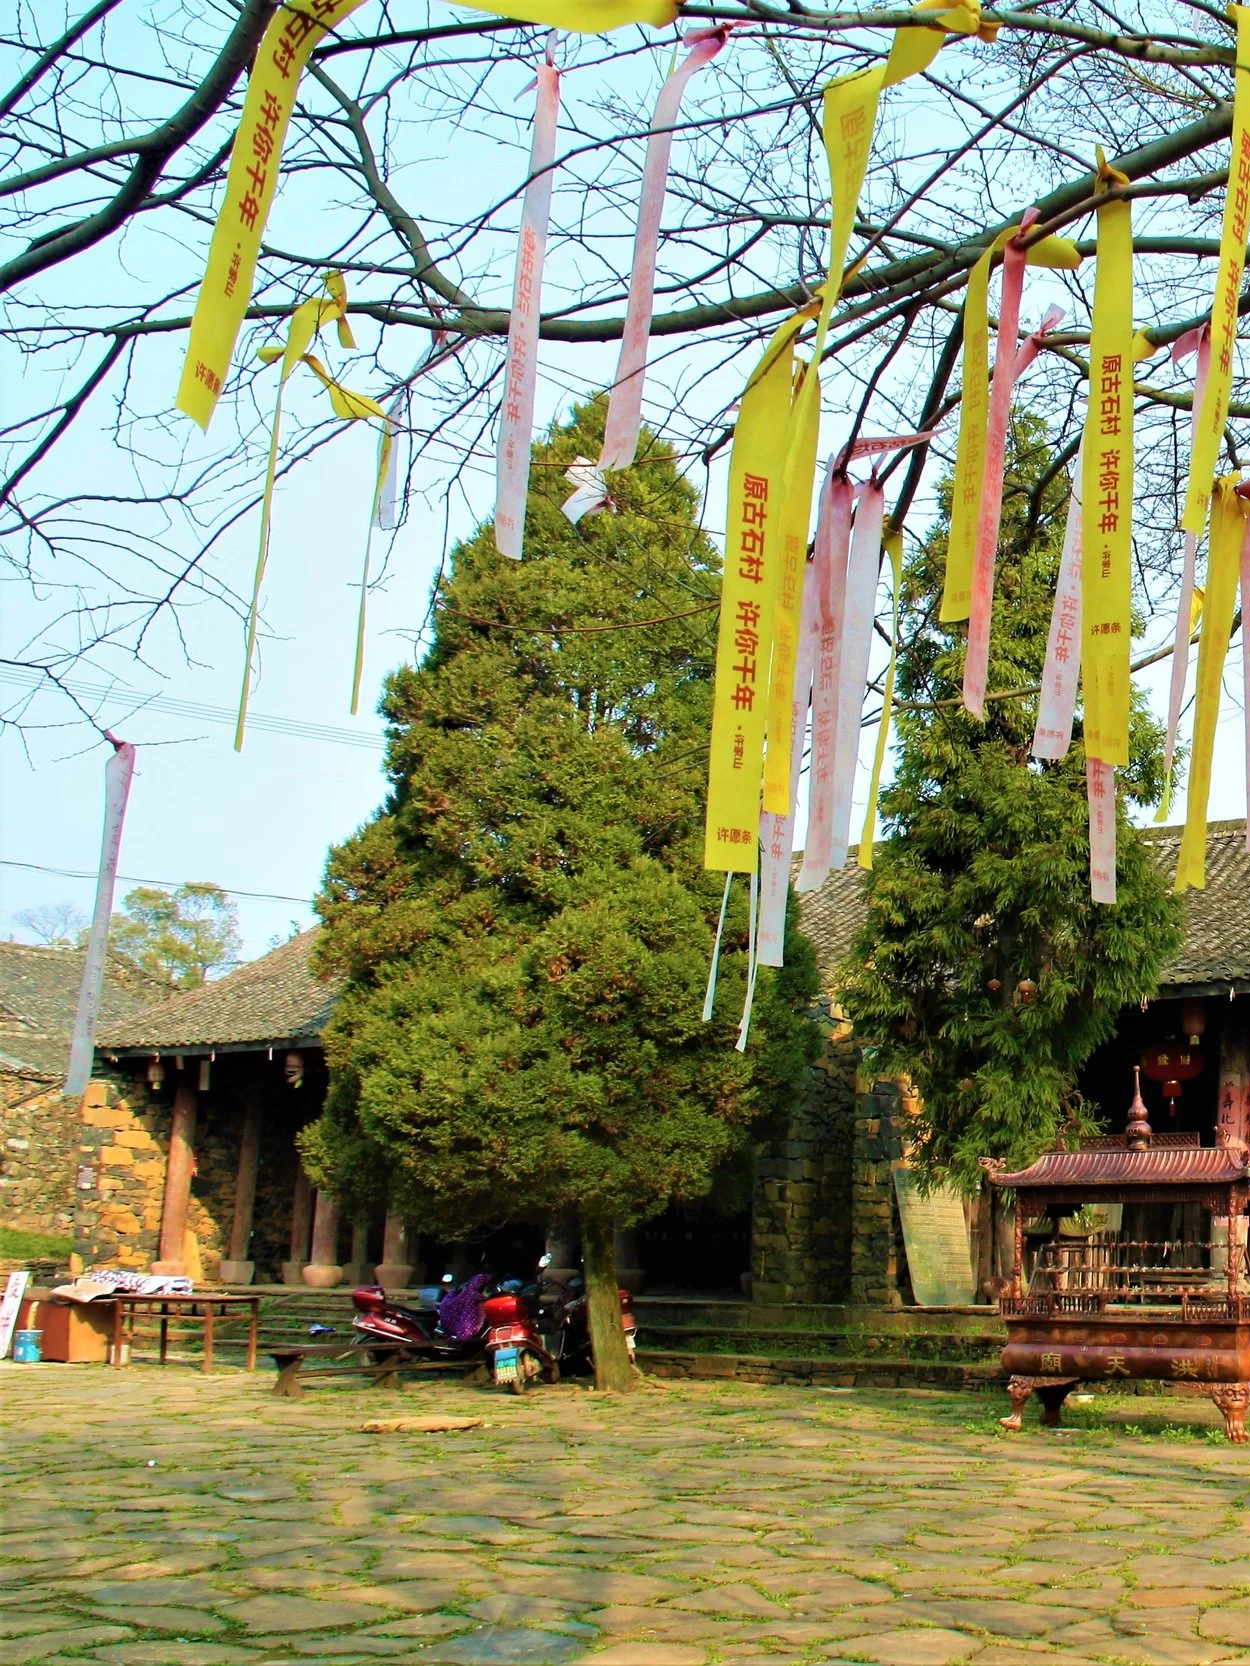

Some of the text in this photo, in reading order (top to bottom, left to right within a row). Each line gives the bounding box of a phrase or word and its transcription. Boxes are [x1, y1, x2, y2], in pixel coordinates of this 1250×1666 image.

[237, 89, 282, 232] 许你千年
[1219, 259, 1241, 376] 许你千年
[1100, 354, 1122, 436] 原古石村
[738, 472, 769, 585] 原古石村
[1098, 448, 1120, 533] 许你千年
[731, 600, 760, 712] 许你千年
[1089, 622, 1122, 635] 许愿条
[716, 827, 752, 845] 许愿条
